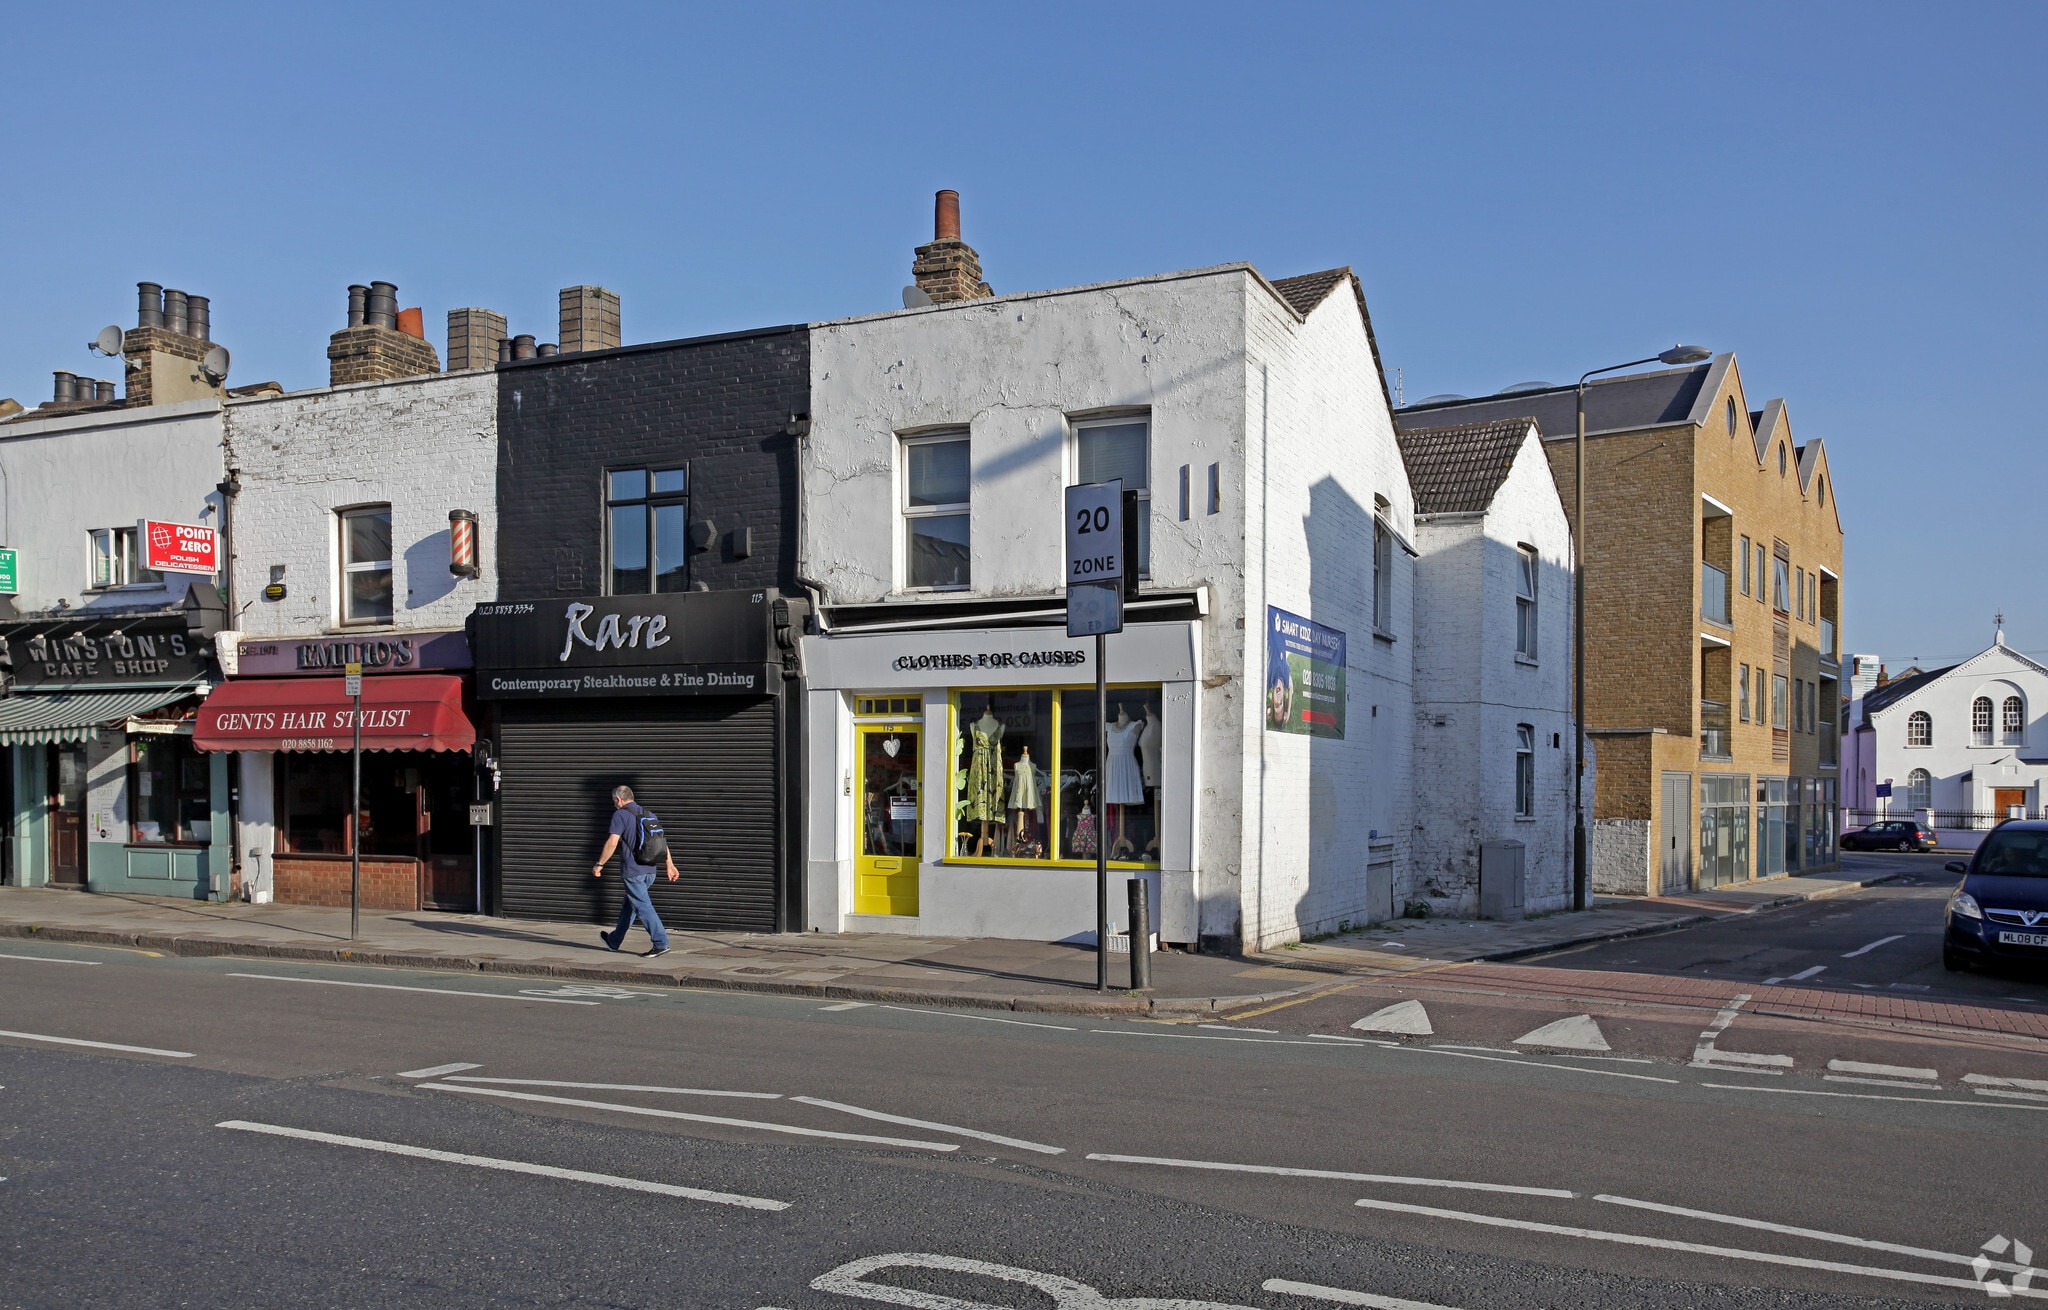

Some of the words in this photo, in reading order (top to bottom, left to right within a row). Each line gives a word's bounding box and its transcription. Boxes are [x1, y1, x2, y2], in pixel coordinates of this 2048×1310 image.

[1076, 505, 1110, 535] 20
[175, 526, 213, 541] POINT
[179, 540, 212, 554] ZERO
[155, 561, 215, 571] DELICATESSEN
[170, 554, 200, 563] POLISH
[1073, 555, 1115, 575] ZONE
[751, 593, 764, 604] 113
[478, 605, 494, 616] 020
[559, 602, 671, 662] Rare
[1281, 619, 1299, 638] SMART
[1299, 624, 1312, 642] KIDZ
[1312, 630, 1322, 644] DAY
[1321, 633, 1341, 650] NURSERY
[26, 634, 187, 662] WINSTON'S
[301, 639, 413, 667] EMILIO'S
[45, 662, 98, 676] CAFE
[114, 659, 169, 674] SHOP
[897, 654, 973, 669] CLOTHES
[977, 652, 1014, 667] FOR
[1018, 650, 1086, 665] CAUSES
[491, 677, 581, 692] Contemporary
[583, 674, 657, 689] Steakhouse
[660, 673, 671, 687] &
[673, 672, 704, 687] Fine
[707, 672, 755, 688] Dining
[1302, 668, 1312, 686] 020
[216, 712, 276, 730] GENTS
[280, 711, 327, 729] HAIR
[333, 709, 411, 728] STYLIST
[883, 724, 895, 732] 115
[282, 739, 297, 749] 020
[298, 738, 316, 749] 8858
[317, 738, 334, 749] 1162
[2002, 932, 2031, 944] ML08
[2033, 935, 2048, 945] CF
